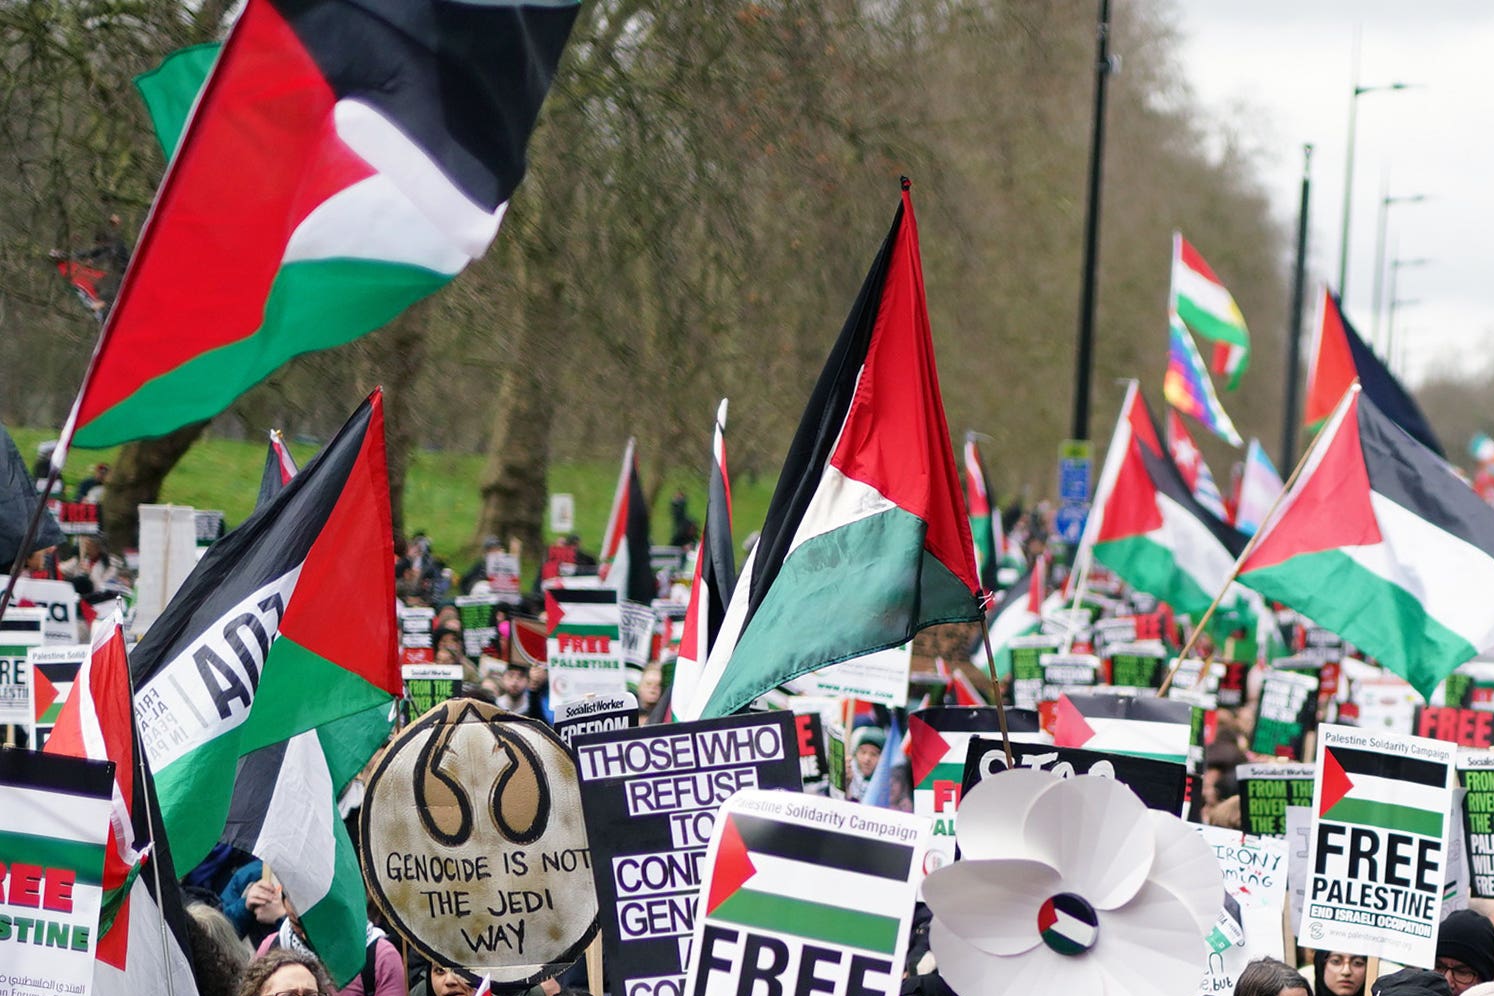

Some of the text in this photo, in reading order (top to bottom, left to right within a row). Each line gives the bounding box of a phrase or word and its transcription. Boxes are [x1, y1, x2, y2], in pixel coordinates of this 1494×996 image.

[556, 633, 611, 654] FREE
[566, 699, 625, 718] Socialist Worker
[1417, 705, 1494, 749] FREE
[580, 726, 782, 778] THOSE WHO
[1324, 731, 1450, 761] Palestine Solidarity Campaign
[630, 769, 755, 815] REFUSE
[1248, 779, 1287, 798] FROM
[784, 802, 846, 831] Solidarity
[849, 815, 919, 842] Campaign
[1249, 815, 1276, 833] THE
[1468, 813, 1493, 833] THE
[386, 848, 591, 882] GENOCIDE IS NOT
[1315, 822, 1442, 894] FREE
[0, 862, 76, 914] EE
[420, 888, 553, 918] THE JEDI
[1311, 877, 1436, 922] PALESTINE
[620, 897, 697, 938] GEN
[1311, 904, 1333, 920] END
[1335, 908, 1377, 926] ISRAELI
[461, 919, 525, 954] WAY
